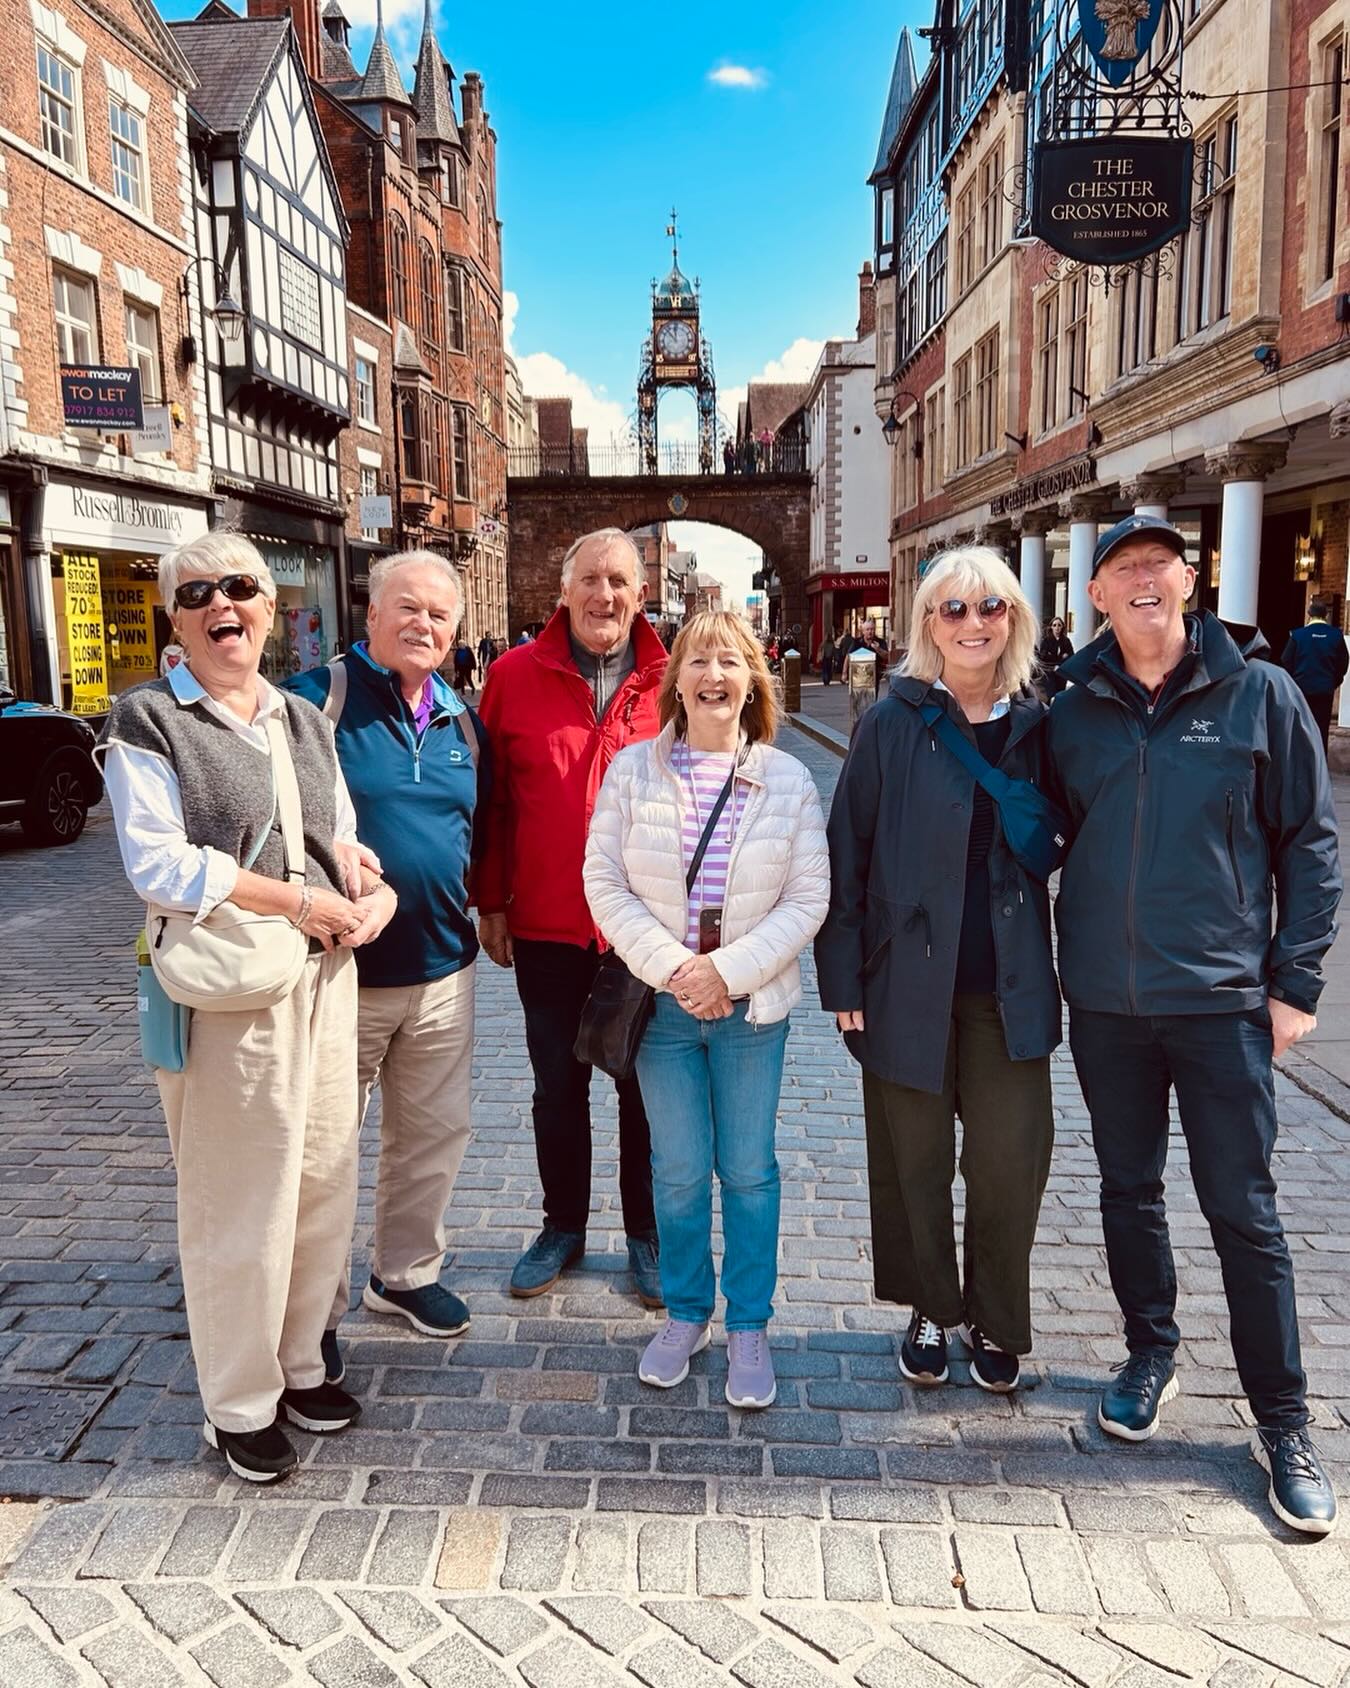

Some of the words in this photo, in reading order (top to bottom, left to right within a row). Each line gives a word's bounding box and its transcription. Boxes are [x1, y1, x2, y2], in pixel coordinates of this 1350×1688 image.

[1093, 159, 1134, 176] THE
[1068, 180, 1155, 198] CHESTER
[1051, 201, 1169, 220] GROSVENOR
[1073, 230, 1130, 239] ESTABLISHED
[60, 367, 132, 383] ewanmackay
[69, 385, 94, 401] TO
[98, 387, 127, 403] LET
[96, 406, 115, 418] 834
[116, 407, 136, 418] 912
[1038, 459, 1092, 500] GROSVENOR
[72, 486, 125, 523] Russell
[131, 496, 184, 537] Bromley
[68, 550, 96, 568] ALL
[274, 556, 303, 573] LOOK
[68, 568, 97, 581] STOCK
[850, 577, 888, 587] MILTON
[72, 622, 101, 640] STORE
[73, 645, 102, 663] CLOSING
[75, 667, 103, 686] DOWN
